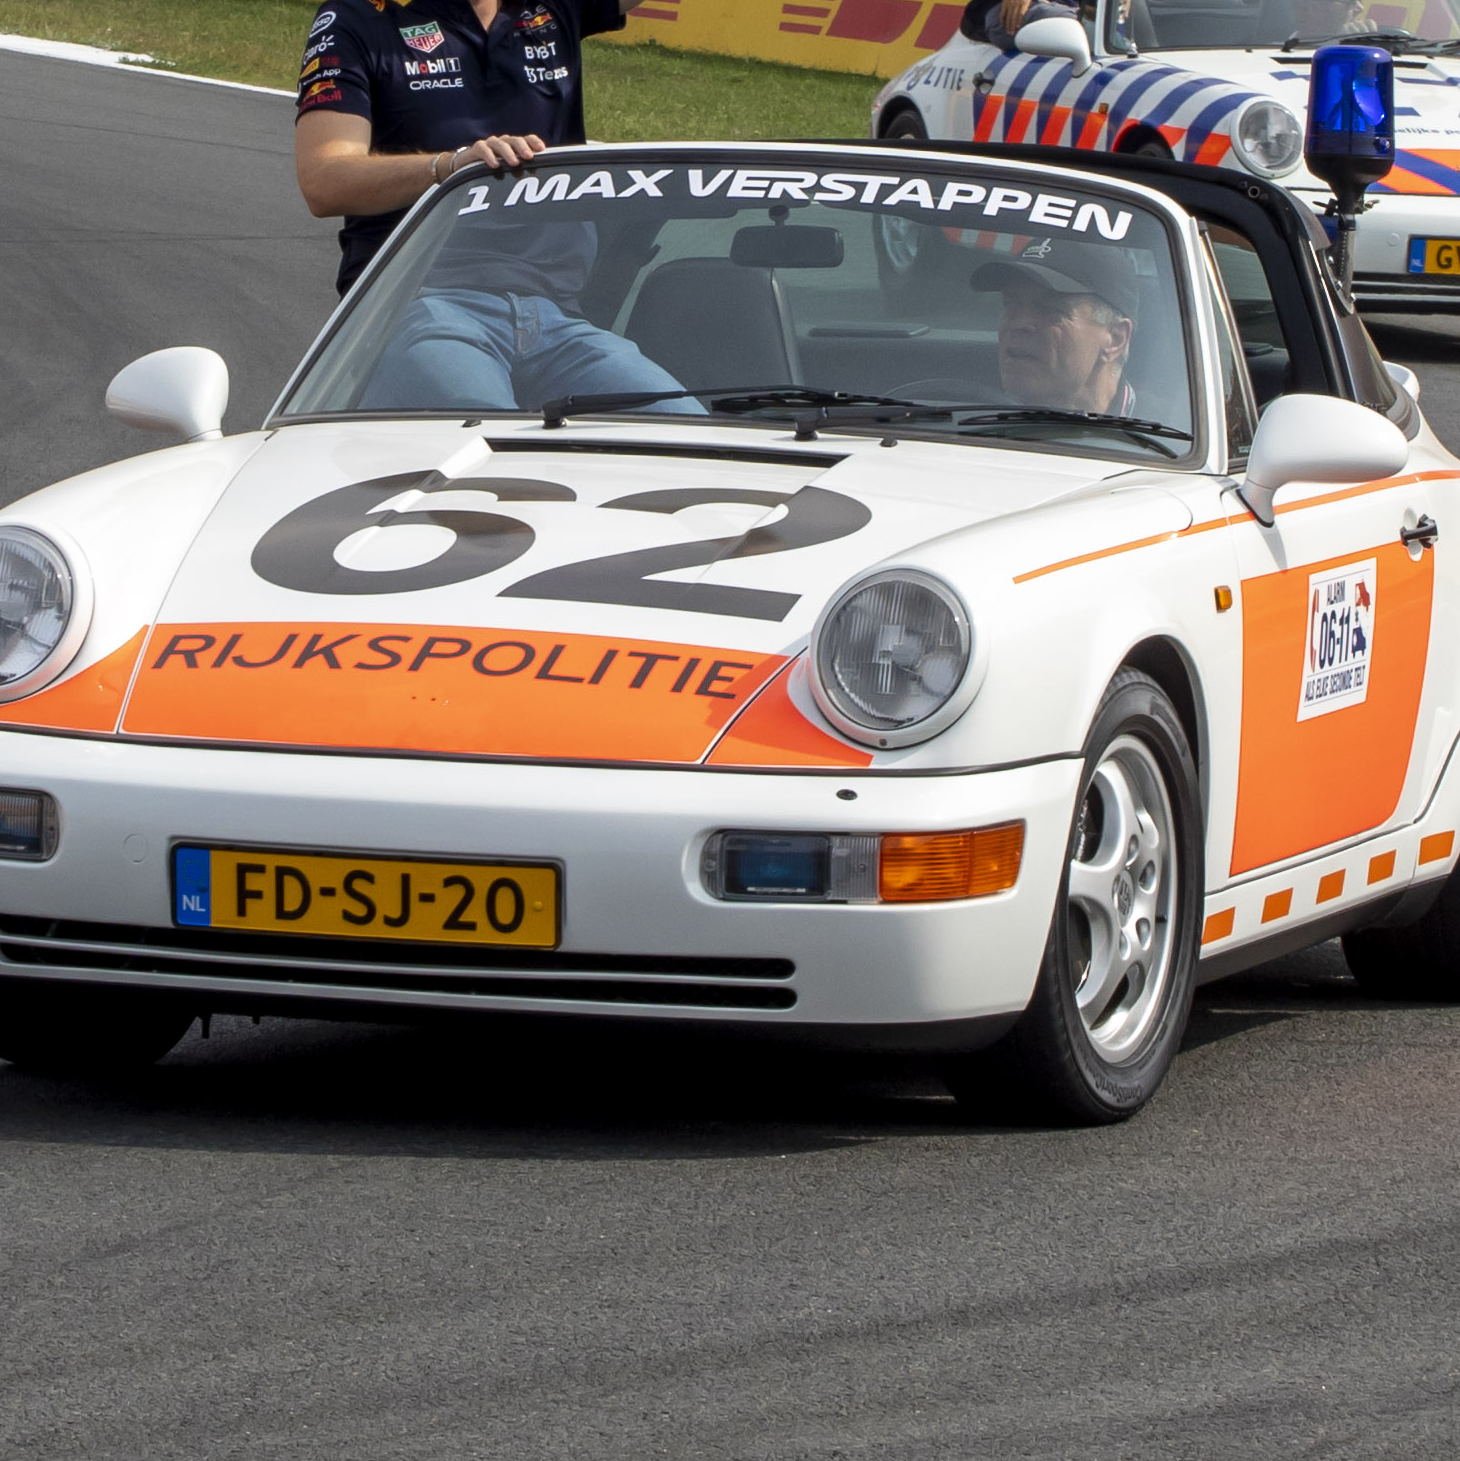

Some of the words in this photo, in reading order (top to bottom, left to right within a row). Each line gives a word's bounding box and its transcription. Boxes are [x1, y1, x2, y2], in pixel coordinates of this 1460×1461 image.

[403, 24, 437, 38] TAG
[406, 34, 444, 51] HEUER
[405, 58, 445, 76] Mobil
[448, 57, 459, 73] 1
[409, 78, 464, 90] ORACLE
[317, 90, 342, 102] Bull
[458, 185, 490, 216] 1
[504, 169, 672, 208] MAX
[687, 169, 1133, 242] VERSTAPPEN
[249, 469, 872, 622] 62
[1327, 580, 1346, 606] ALARM
[1319, 606, 1351, 669] 06-11
[150, 632, 754, 700] RIJKSPOLITIE
[182, 894, 207, 913] NL
[235, 861, 525, 934] FD-SJ-20
